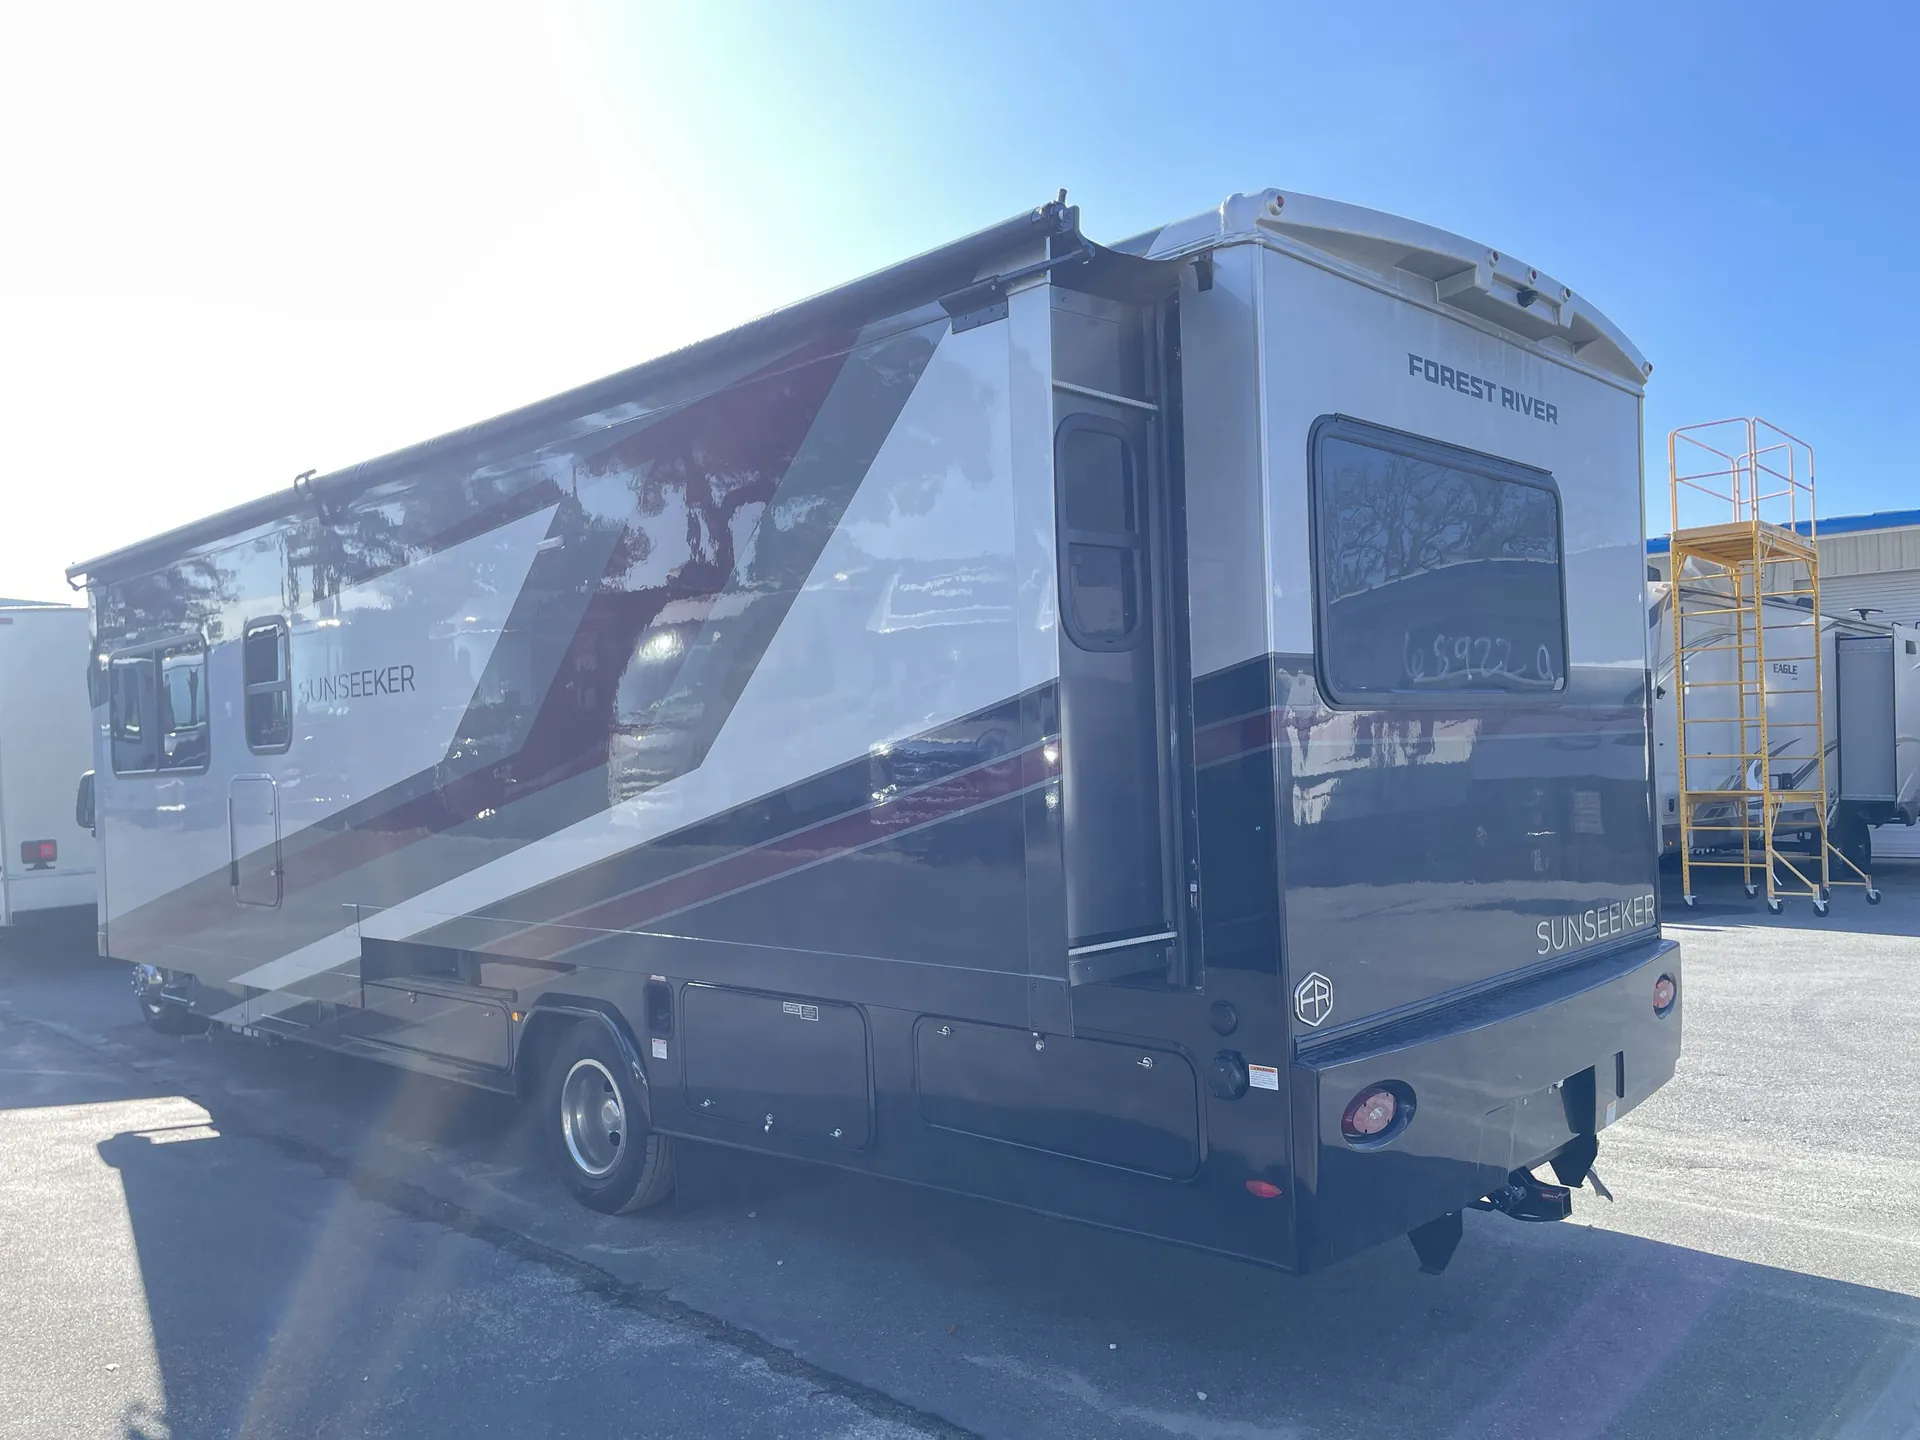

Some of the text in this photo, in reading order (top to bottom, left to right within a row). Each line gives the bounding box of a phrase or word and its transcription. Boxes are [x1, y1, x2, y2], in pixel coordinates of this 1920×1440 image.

[1408, 353, 1558, 425] FOREST RIVER
[299, 664, 416, 704] SUNSEEKER
[1773, 663, 1798, 674] EAGLE
[1536, 894, 1656, 955] SUNSEEKER
